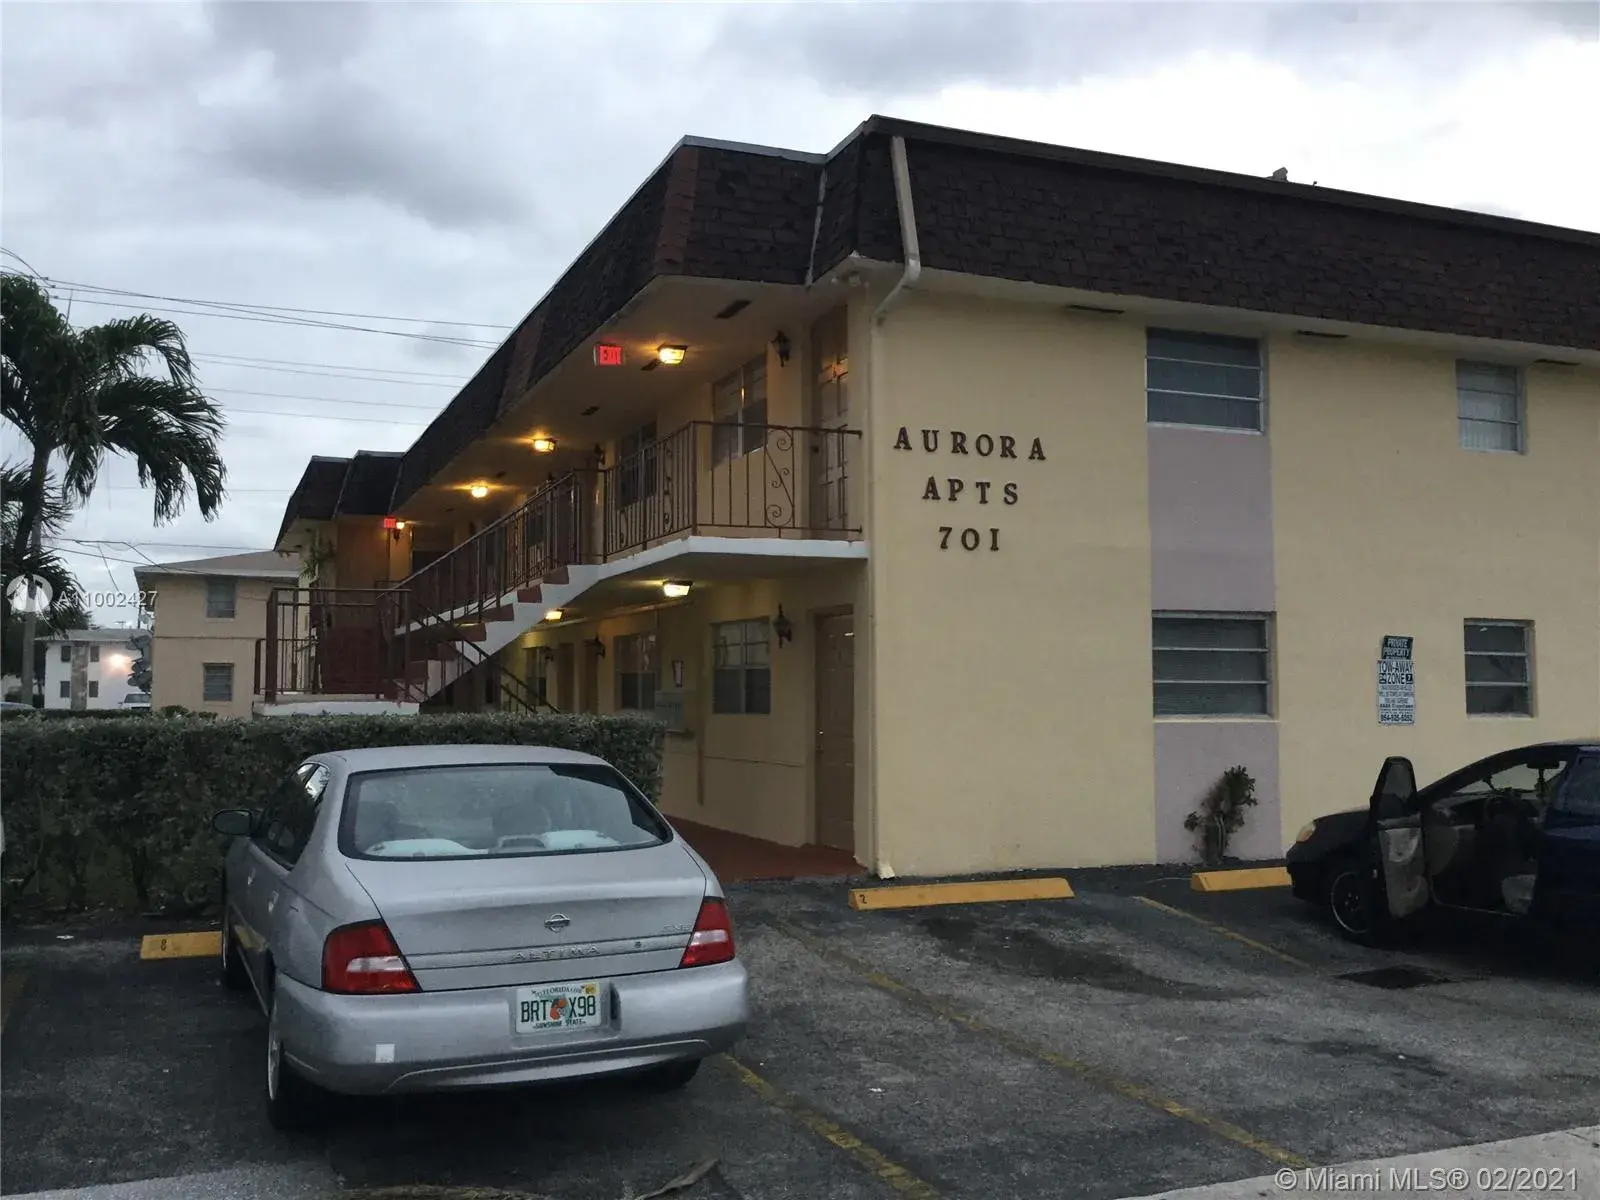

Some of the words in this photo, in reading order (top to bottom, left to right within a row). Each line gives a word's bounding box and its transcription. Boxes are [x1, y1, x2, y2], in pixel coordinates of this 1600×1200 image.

[893, 426, 1046, 461] AURORA
[922, 476, 1018, 505] APTS
[1383, 647, 1410, 656] PROPERTY
[1379, 661, 1413, 673] TOW-AWAY
[1387, 673, 1405, 684] ZONE
[160, 938, 167, 951] 8
[512, 945, 600, 961] ALTIMA
[520, 999, 549, 1023] BRT
[568, 995, 596, 1018] X98
